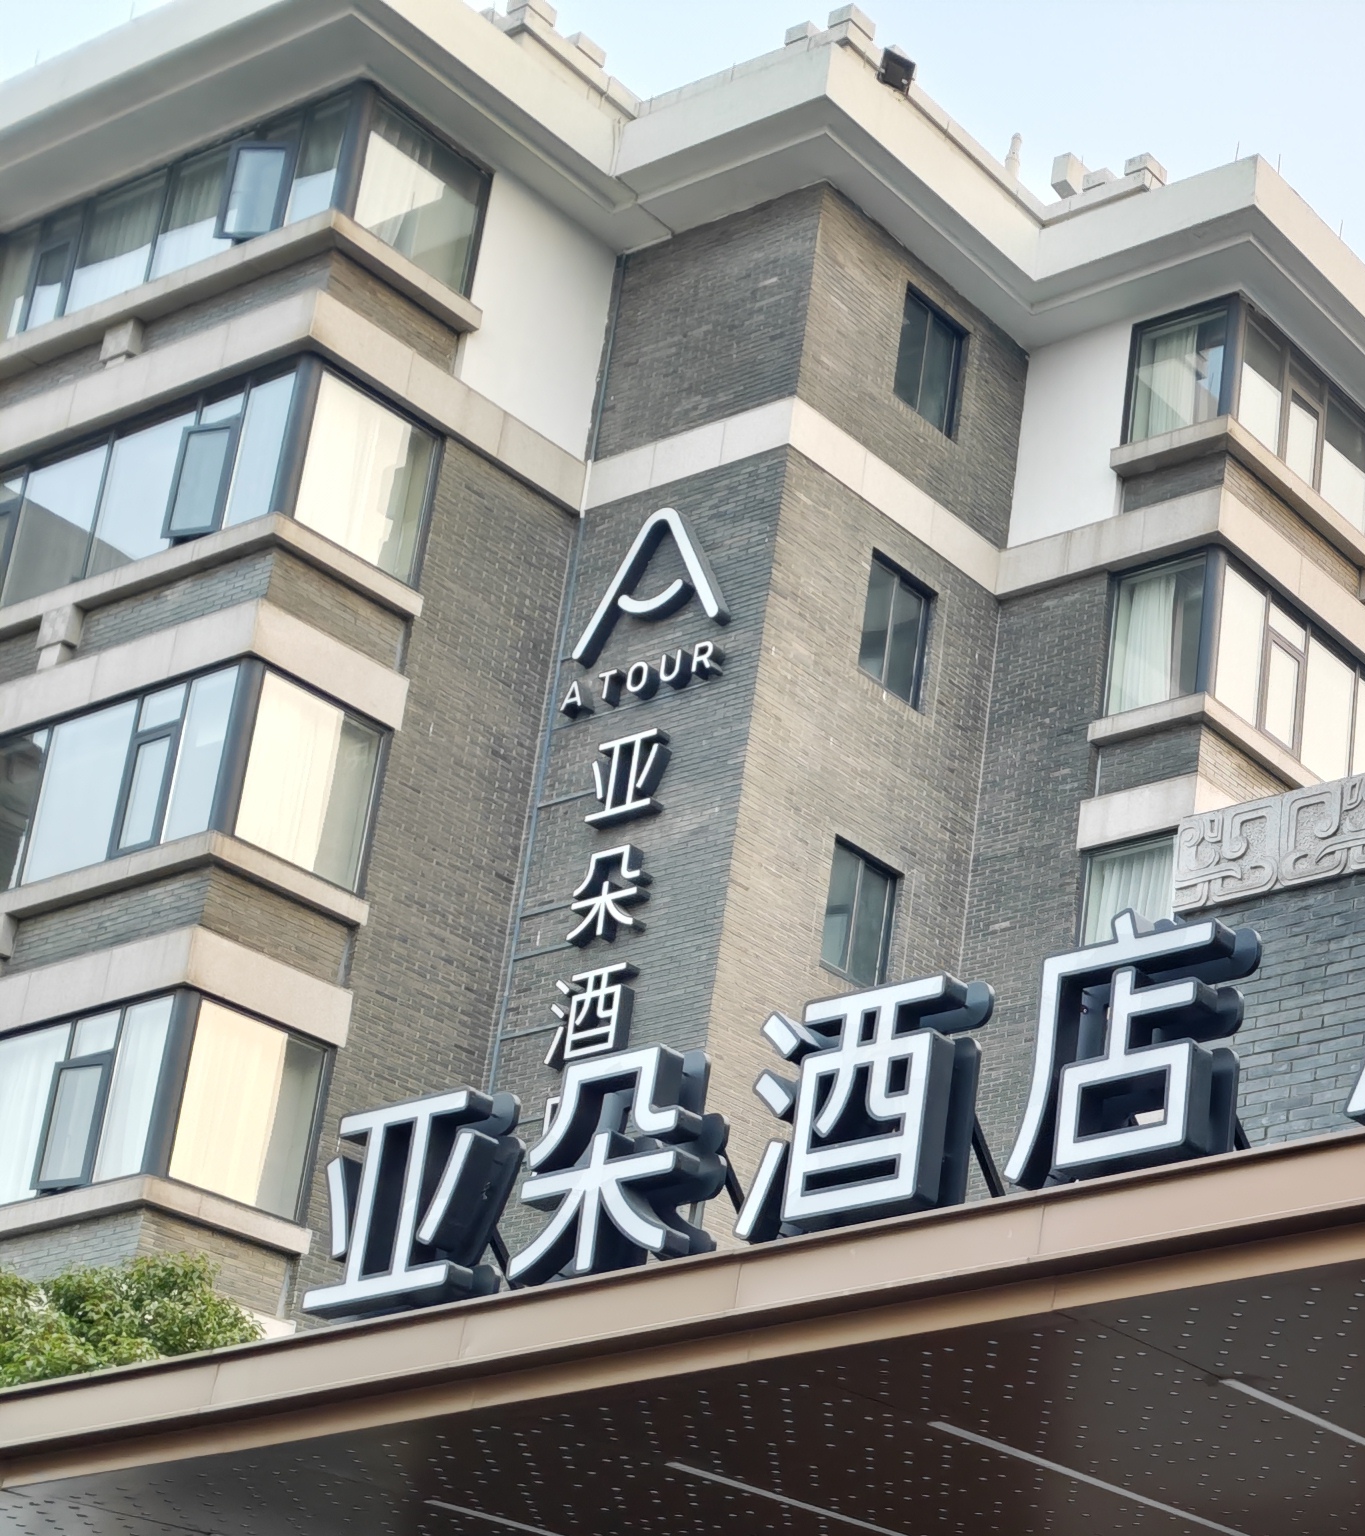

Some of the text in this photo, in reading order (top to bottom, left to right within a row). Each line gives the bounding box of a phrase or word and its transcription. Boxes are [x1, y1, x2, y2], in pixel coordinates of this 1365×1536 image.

[560, 641, 715, 712] ATOUR
[303, 910, 1228, 1316] 亚朵酒店
[543, 727, 662, 1140] 亚朵酒
